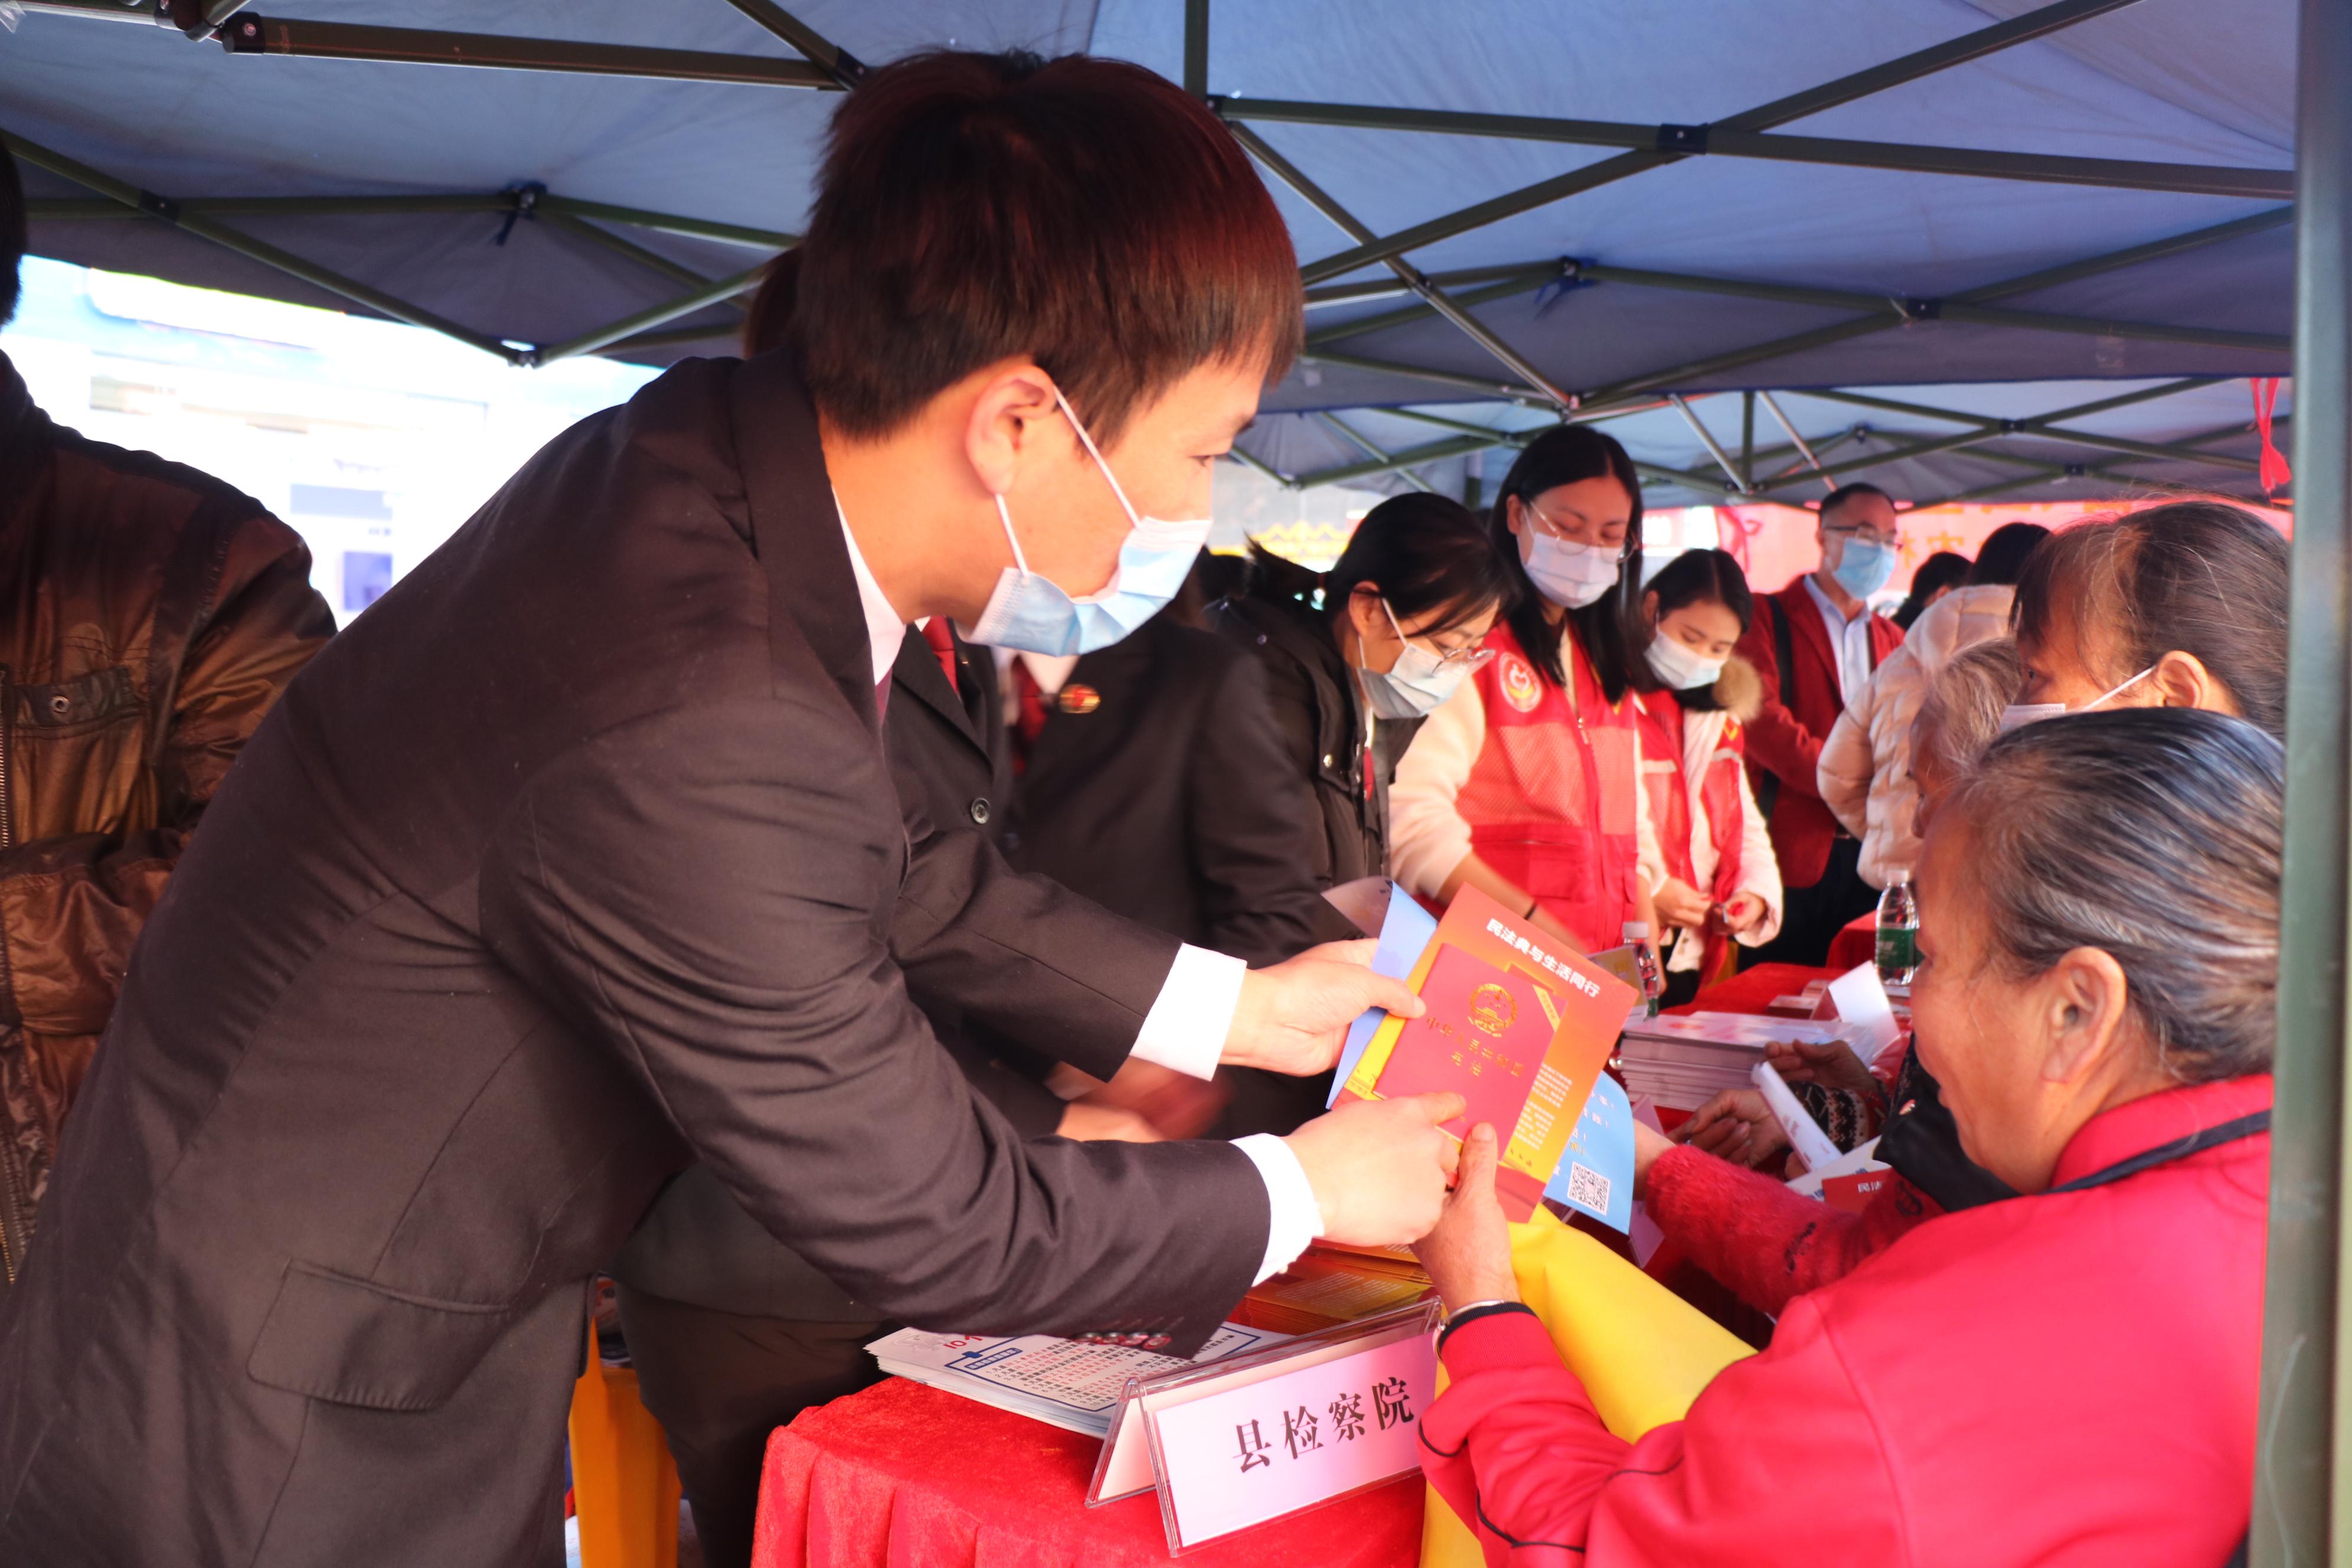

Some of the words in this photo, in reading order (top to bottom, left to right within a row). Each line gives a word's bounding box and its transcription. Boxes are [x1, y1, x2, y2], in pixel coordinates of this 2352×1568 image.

[1486, 918, 1601, 998] 民法典与生活同行
[1427, 1017, 1524, 1077] 中华人民共和国
[1231, 1377, 1416, 1474] 县检察院
